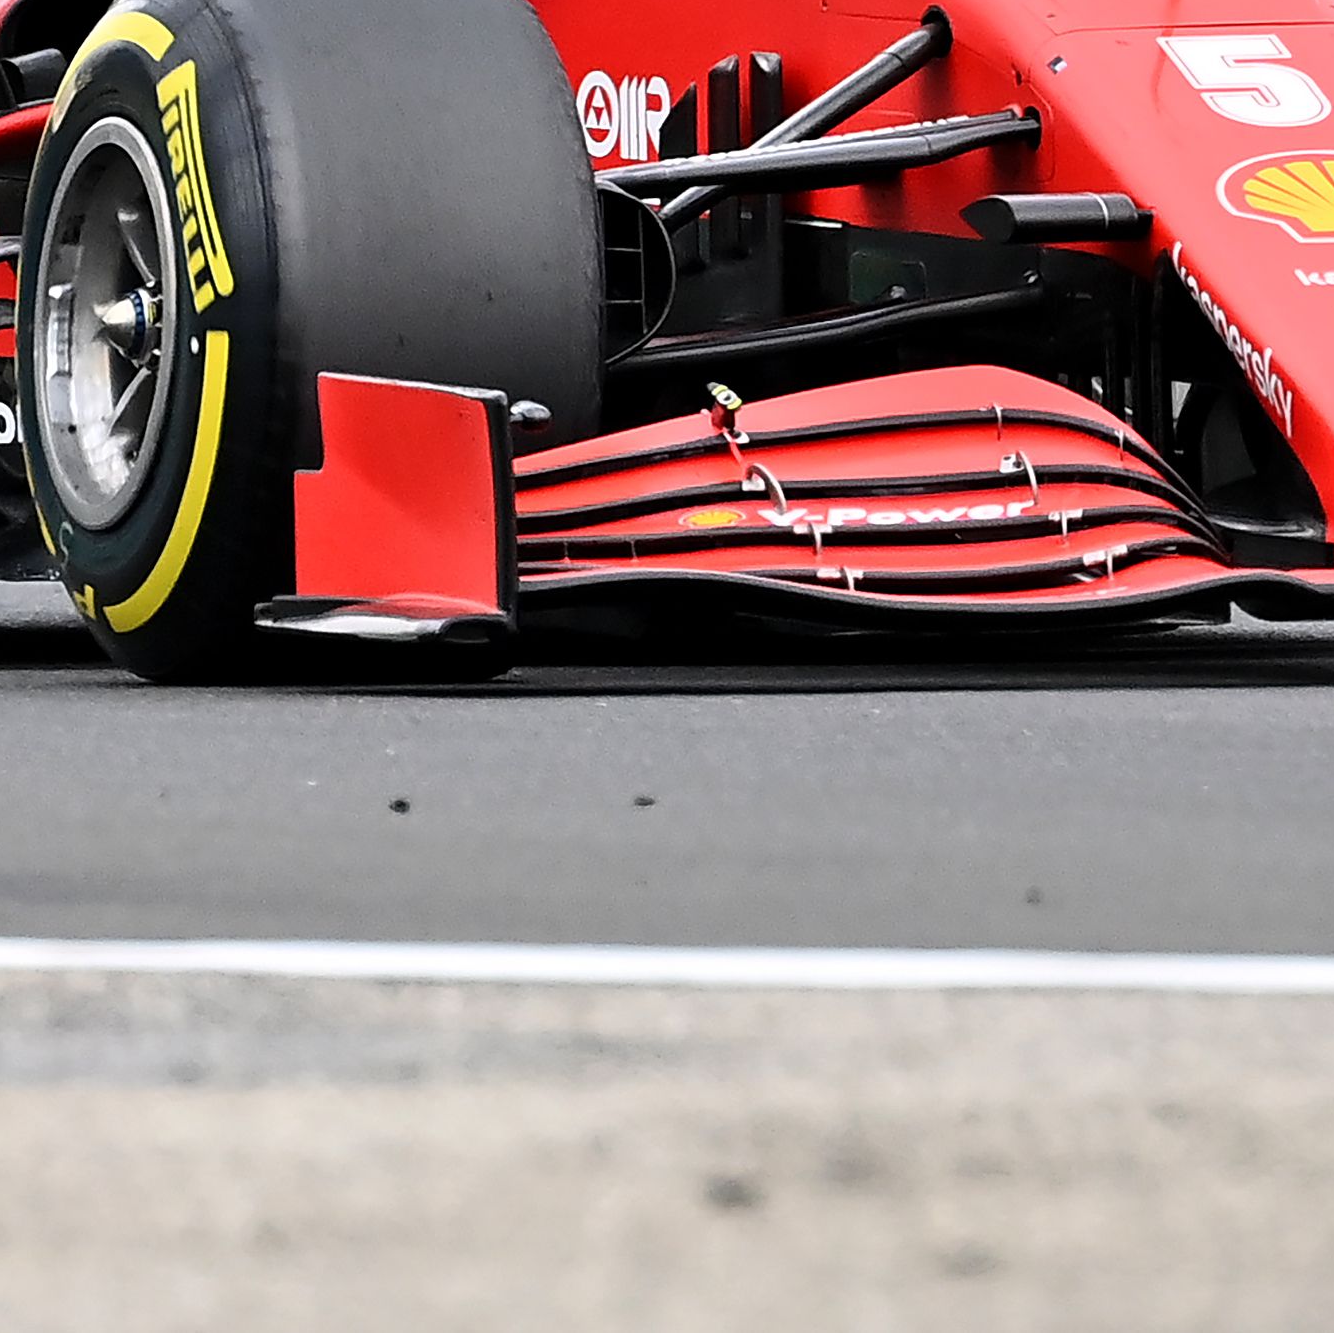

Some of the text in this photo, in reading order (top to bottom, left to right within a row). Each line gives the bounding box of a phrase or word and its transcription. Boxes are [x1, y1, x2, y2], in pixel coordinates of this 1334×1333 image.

[1155, 33, 1333, 127] 5
[156, 58, 235, 314] PIRELLI
[758, 500, 1035, 526] V-Power
